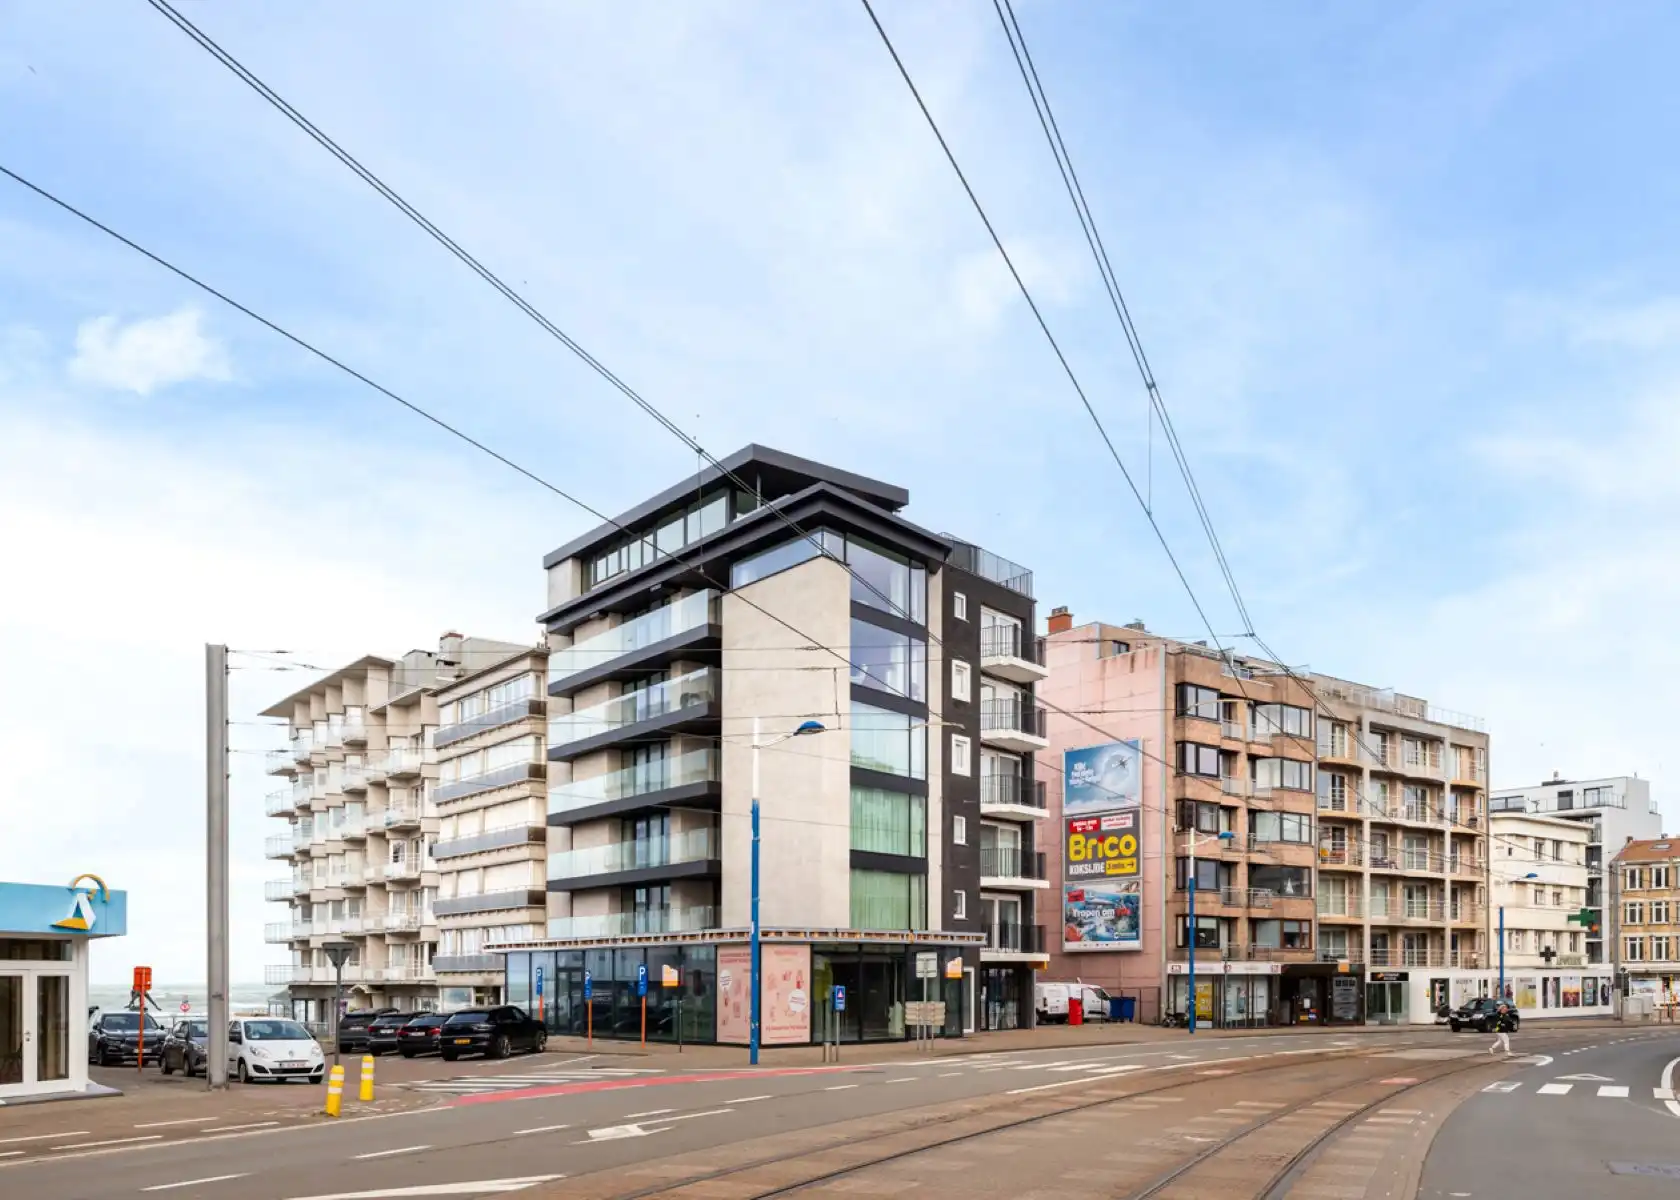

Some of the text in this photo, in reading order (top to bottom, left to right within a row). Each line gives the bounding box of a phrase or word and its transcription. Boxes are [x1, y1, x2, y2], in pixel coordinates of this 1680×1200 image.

[1069, 833, 1137, 861] Brico
[1069, 862, 1105, 875] KOKSIJDE
[640, 966, 646, 980] P
